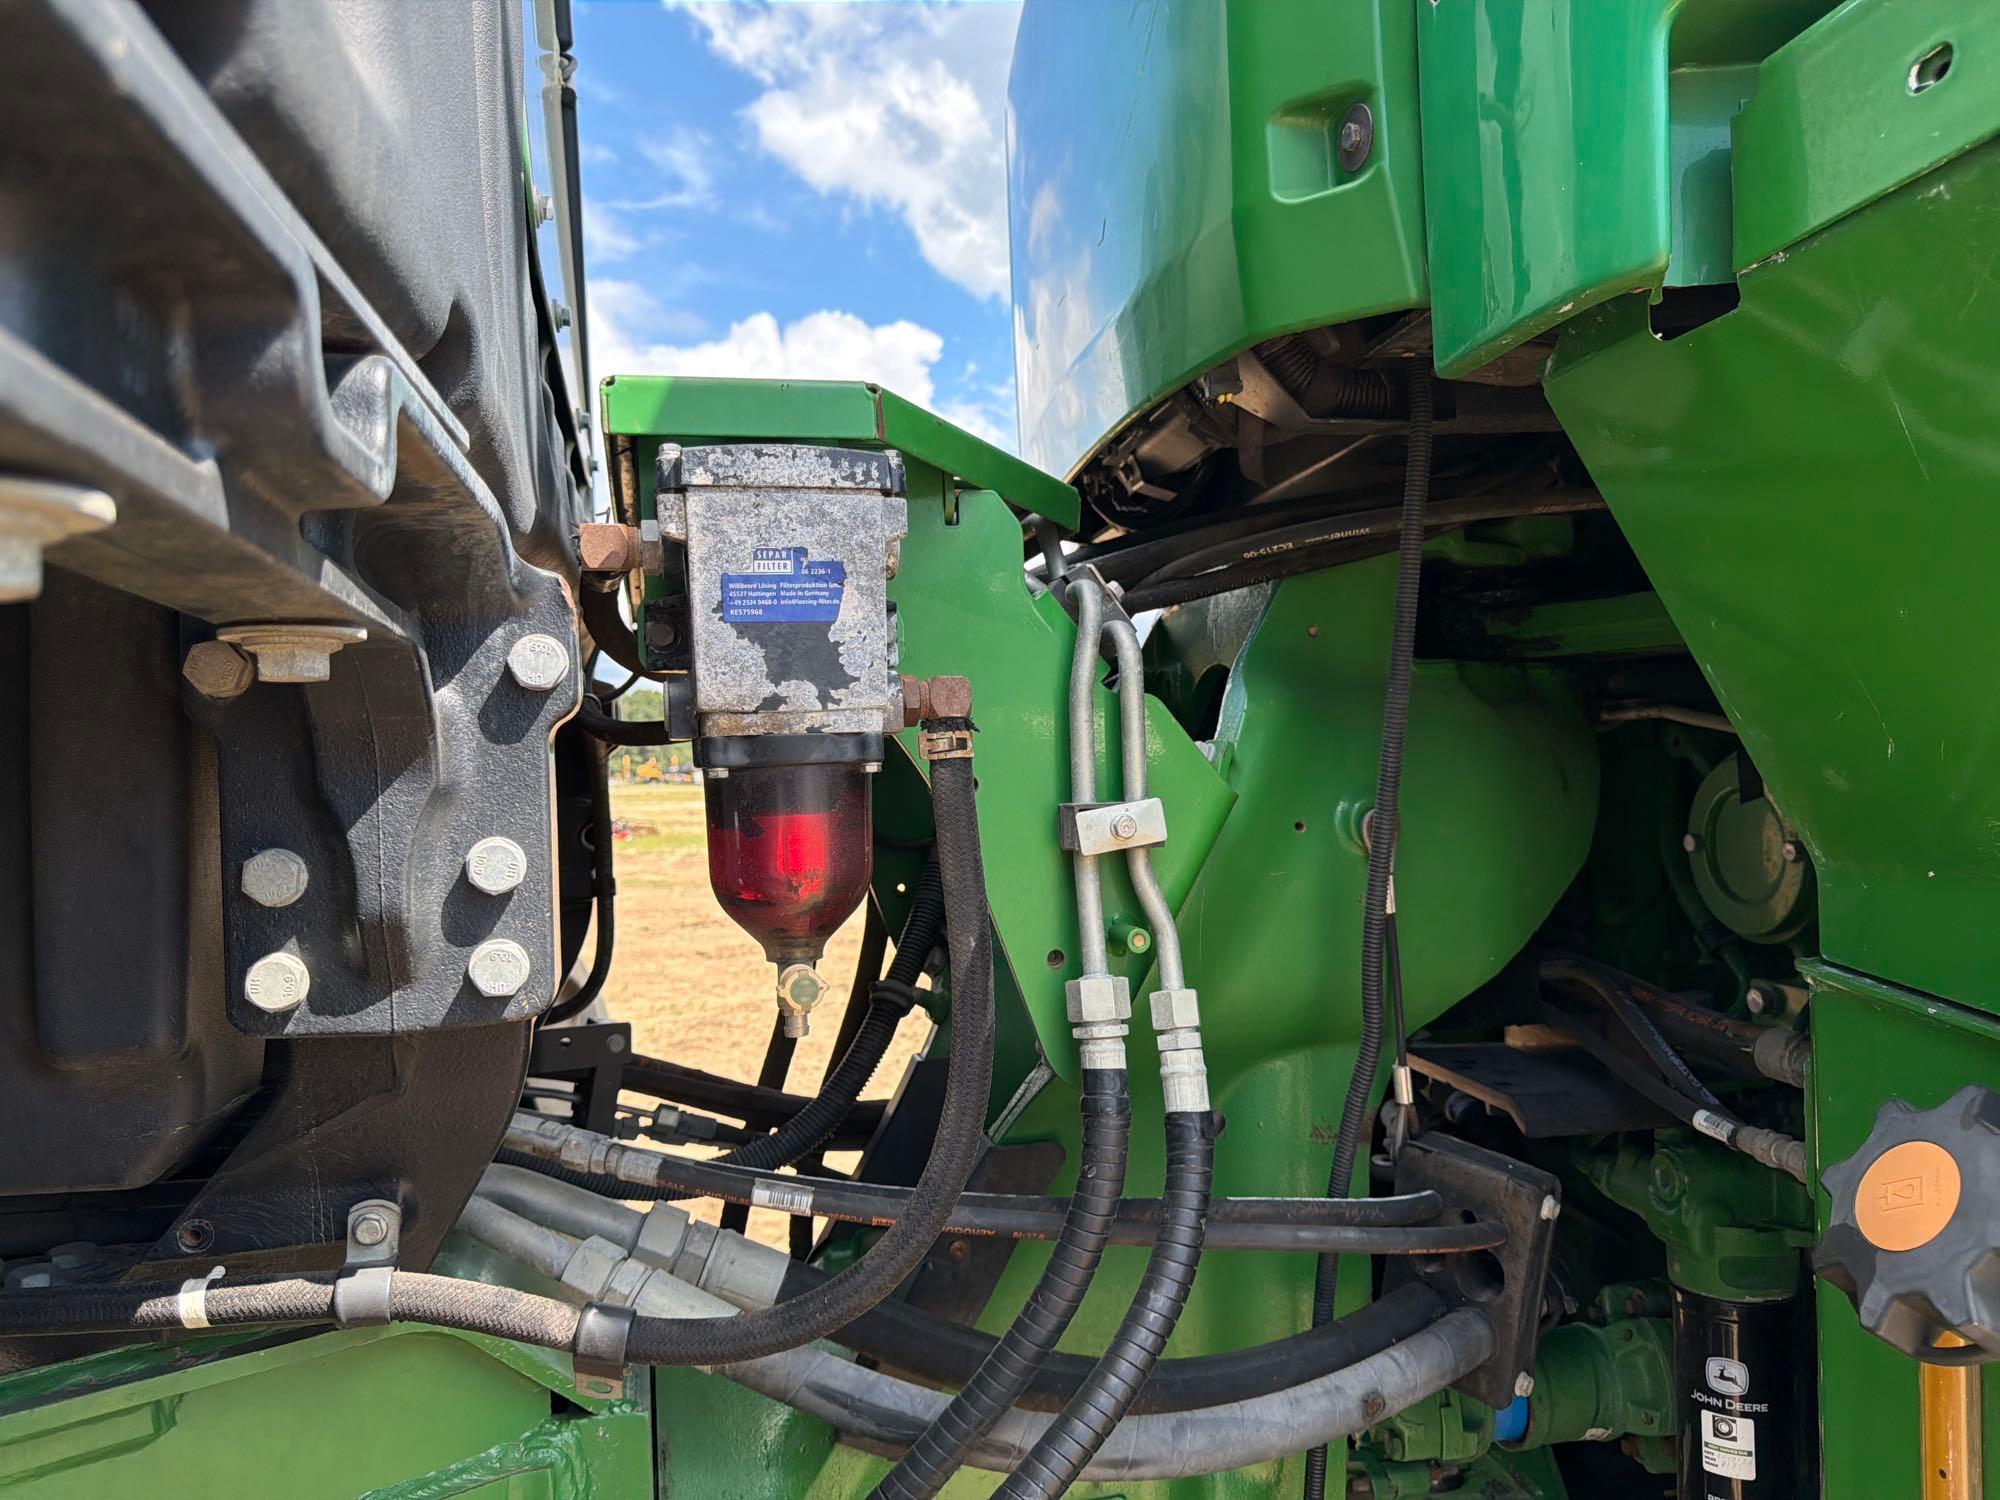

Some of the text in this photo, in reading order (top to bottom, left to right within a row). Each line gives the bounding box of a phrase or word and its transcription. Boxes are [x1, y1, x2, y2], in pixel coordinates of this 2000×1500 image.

[1329, 528, 1370, 540] Winner
[756, 550, 787, 559] SEPAR
[1243, 542, 1294, 559] EC215-06
[757, 562, 788, 571] FILTER
[810, 567, 831, 575] 2236-1
[758, 582, 777, 590] Lösing
[474, 852, 487, 875] 10.9
[1690, 1388, 1769, 1412] JOHN DEERE
